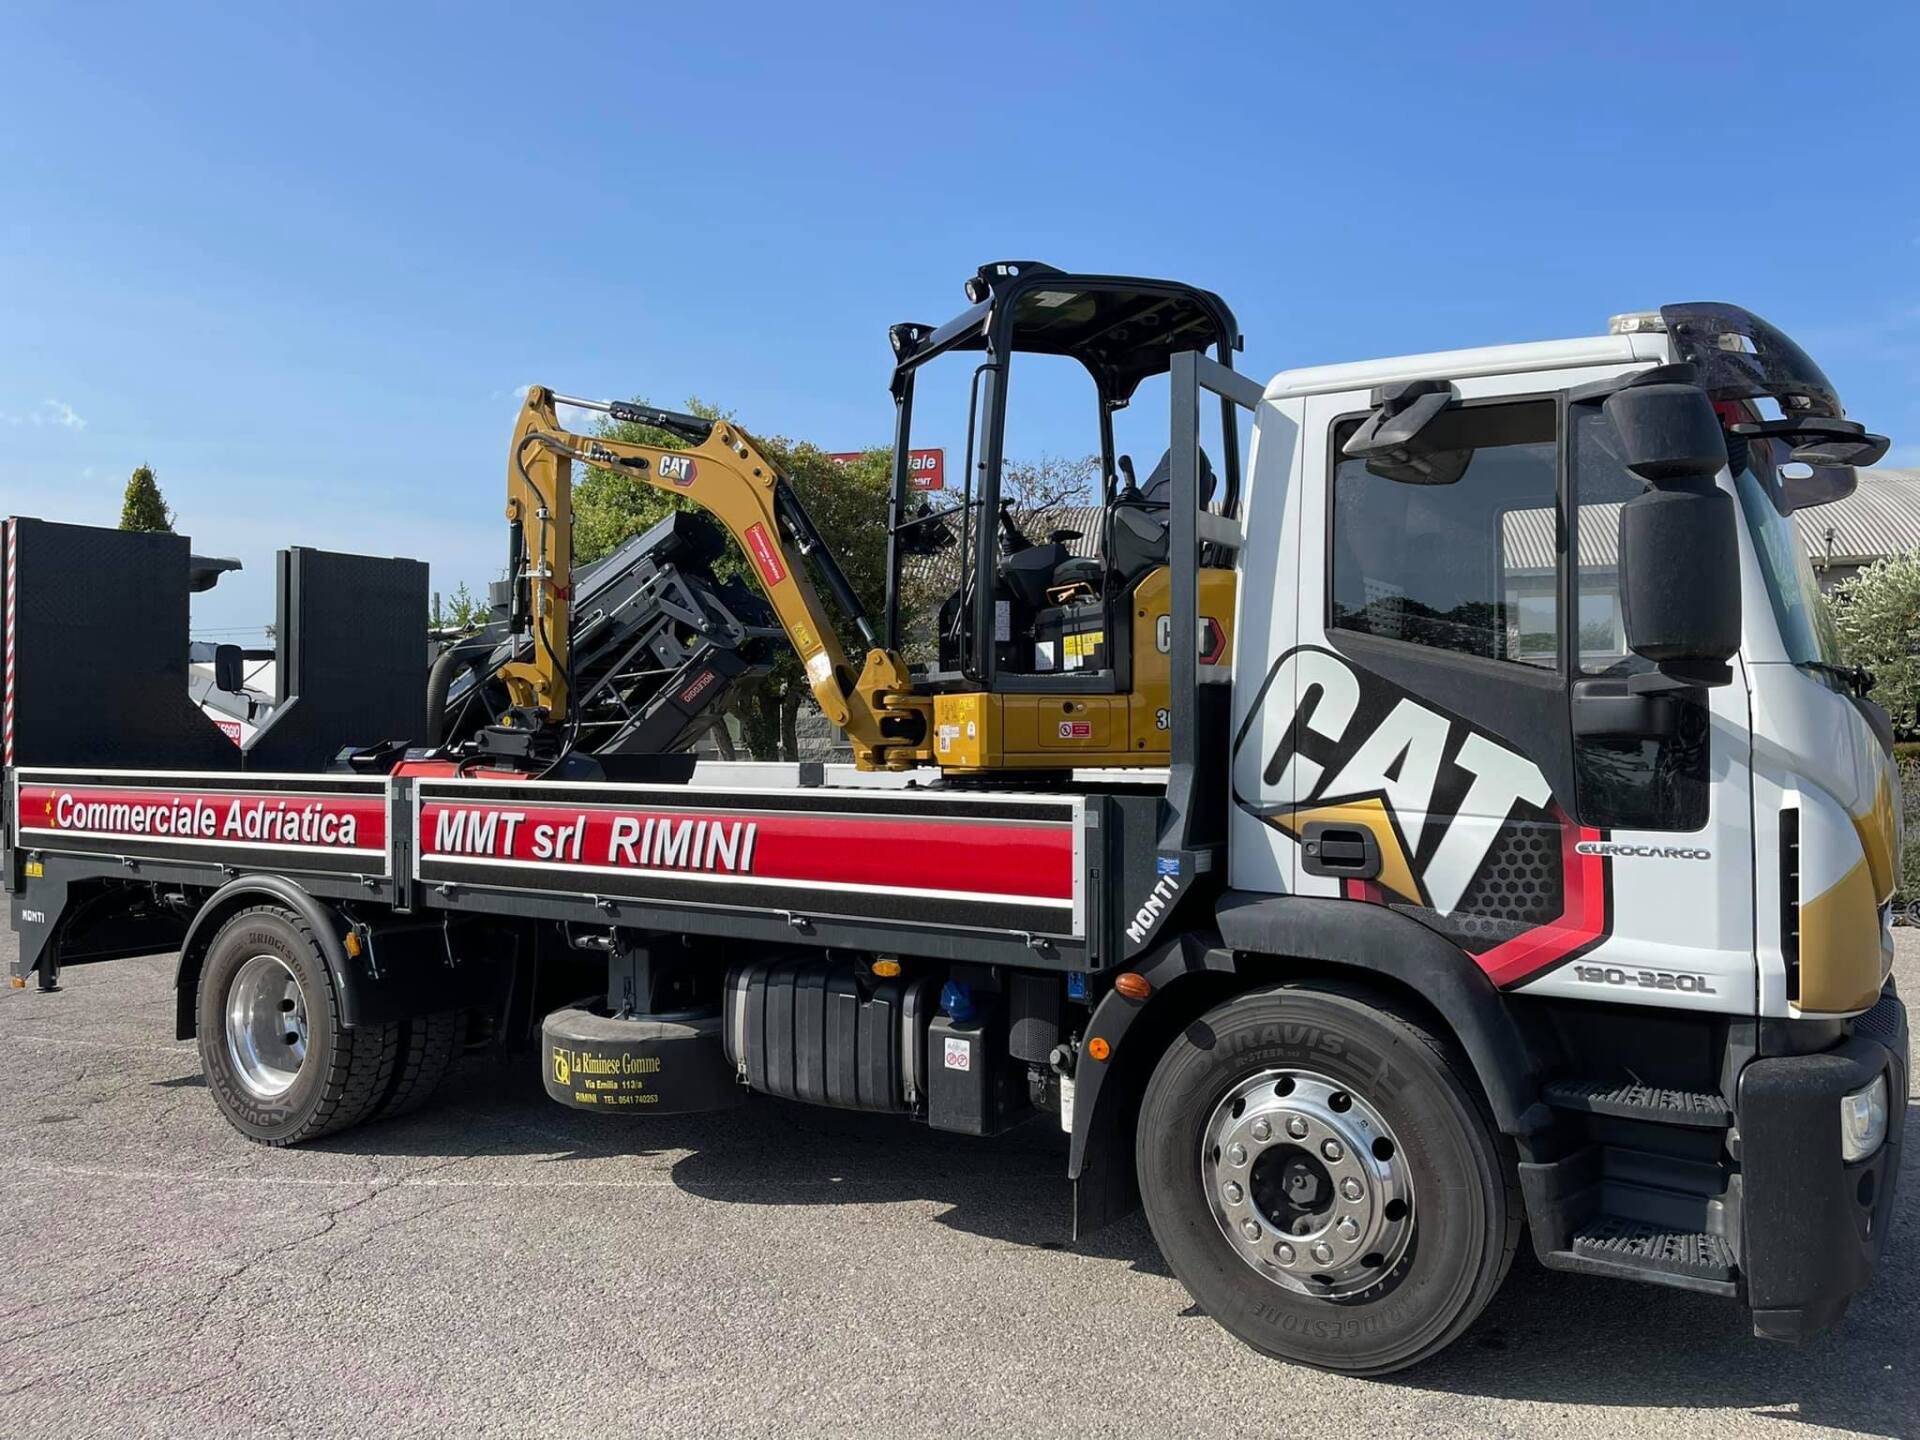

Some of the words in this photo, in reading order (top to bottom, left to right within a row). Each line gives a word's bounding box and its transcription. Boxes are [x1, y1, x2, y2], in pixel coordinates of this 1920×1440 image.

[659, 455, 690, 480] CAT
[1234, 650, 1553, 917] CAT
[57, 793, 216, 837] Commerciale
[223, 800, 357, 845] Adriatica
[434, 809, 525, 856] MMT
[531, 815, 586, 860] srl
[608, 816, 757, 872] RIMINI
[1577, 843, 1712, 861] EUROCARGO
[22, 909, 45, 924] MONTI
[1126, 874, 1179, 943] MONTI
[1574, 965, 1717, 994] 190-320L
[571, 1051, 581, 1072] La
[582, 1052, 620, 1073] Riminese
[622, 1052, 661, 1074] Gomme
[584, 1079, 596, 1090] Via
